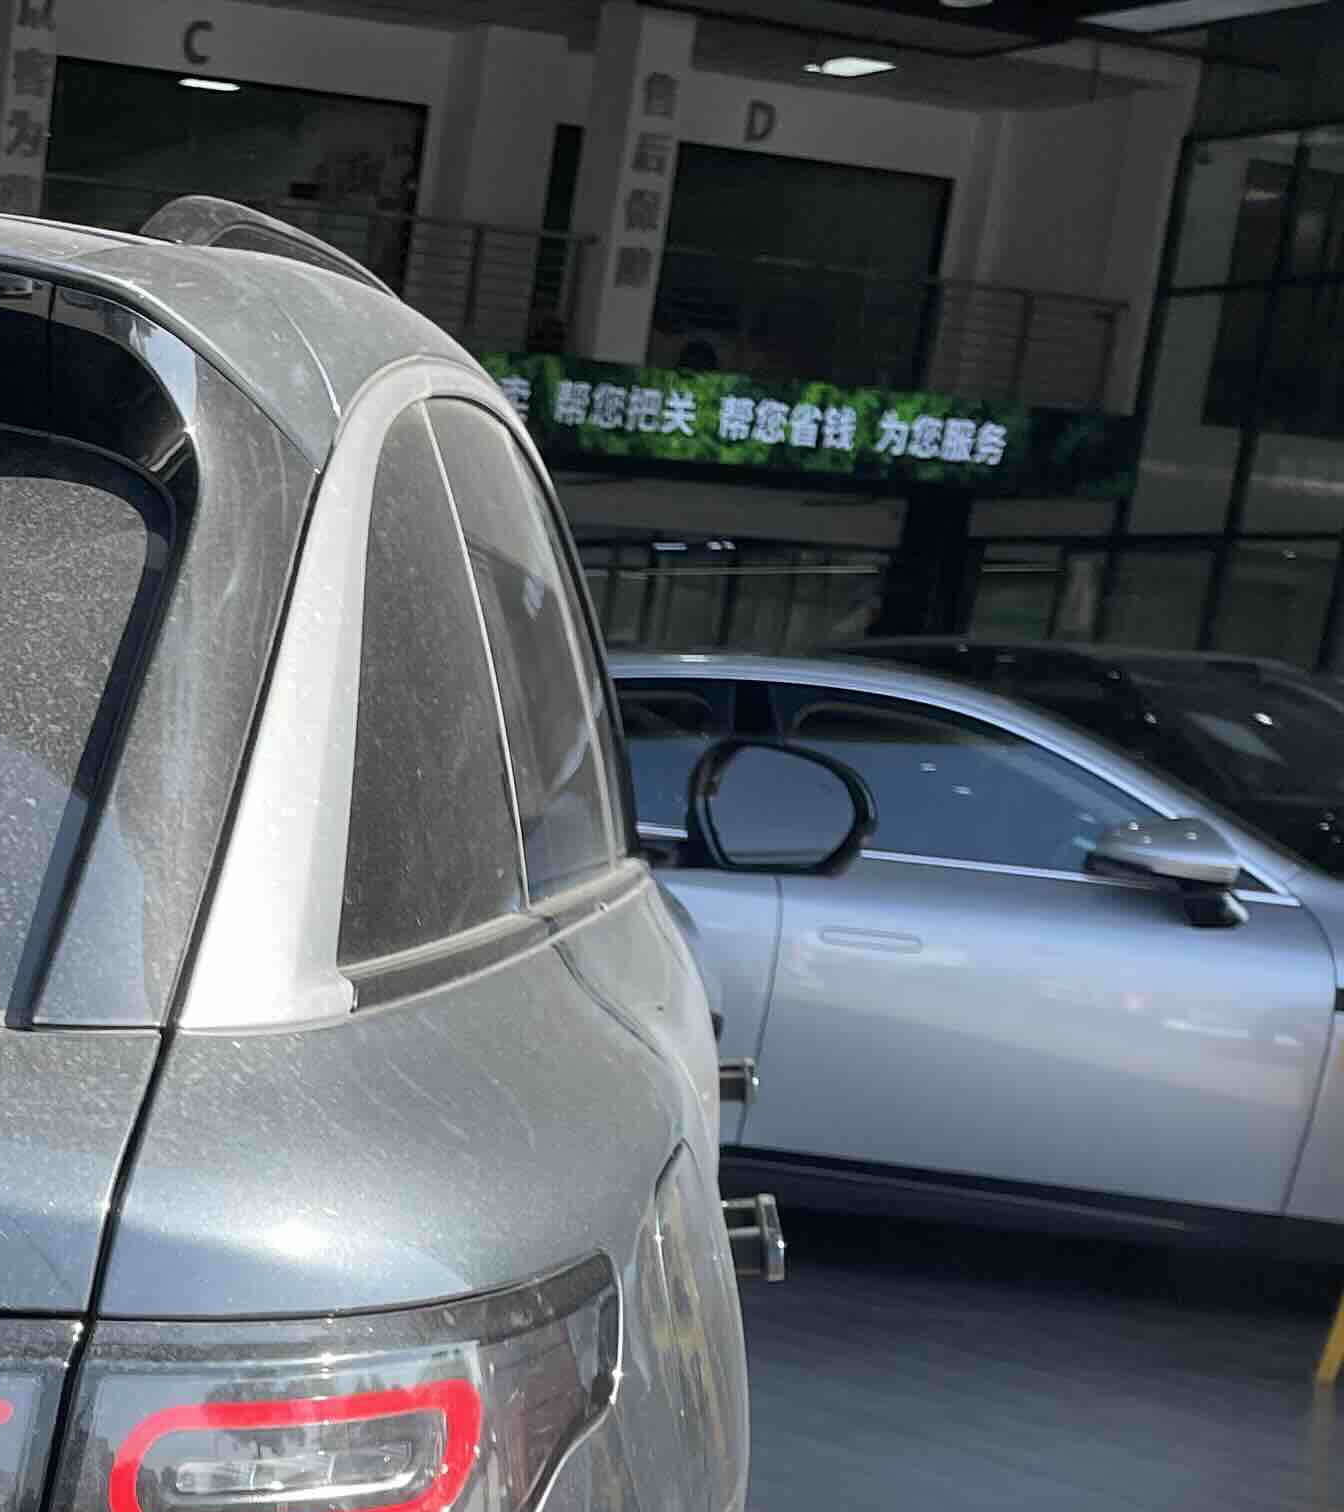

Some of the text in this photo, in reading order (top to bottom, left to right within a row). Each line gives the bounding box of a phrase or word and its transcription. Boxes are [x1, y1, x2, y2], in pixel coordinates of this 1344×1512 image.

[183, 21, 214, 64] C
[744, 99, 776, 141] D
[553, 380, 698, 437] 帮您把关
[717, 395, 857, 451] 帮您省钱
[875, 408, 1009, 467] 为您服务
